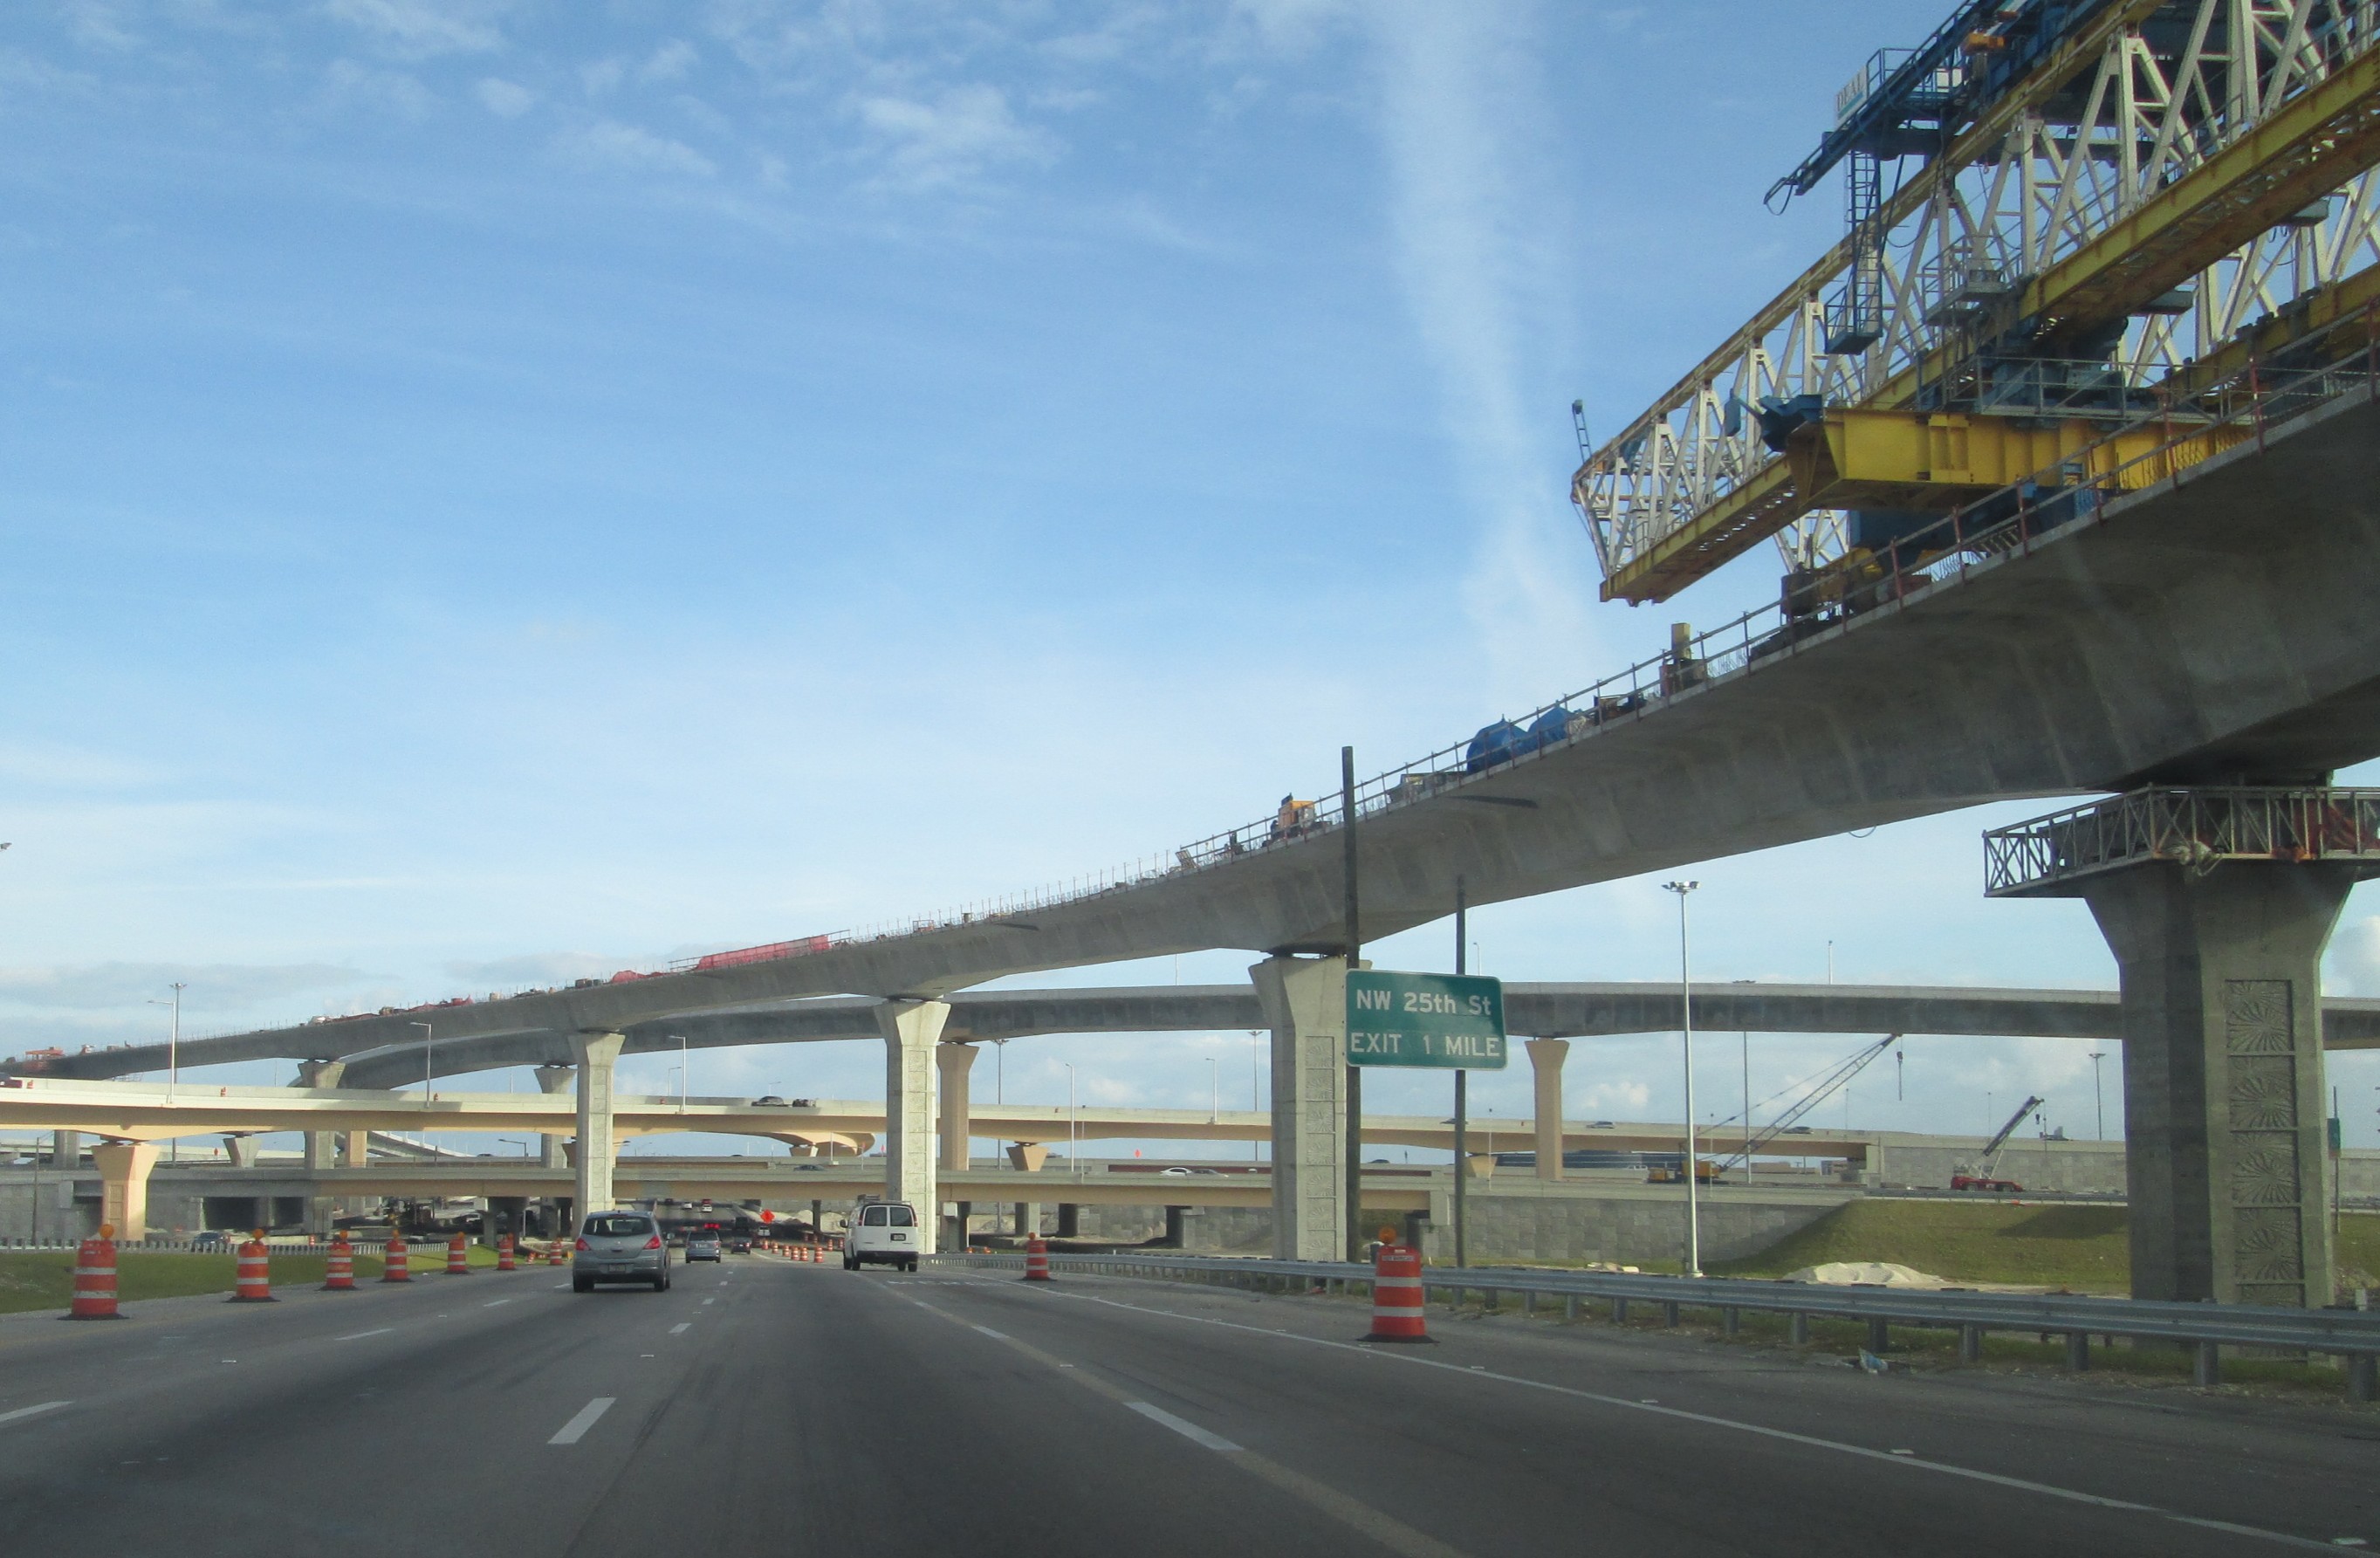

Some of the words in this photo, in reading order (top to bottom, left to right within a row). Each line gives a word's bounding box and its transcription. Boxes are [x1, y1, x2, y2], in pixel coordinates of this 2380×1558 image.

[1356, 989, 1391, 1011] NW
[1403, 992, 1457, 1014] 25th
[1468, 995, 1492, 1016] St
[1351, 1033, 1402, 1054] EXIT
[1423, 1035, 1430, 1054] 1
[1445, 1035, 1500, 1057] MILE
